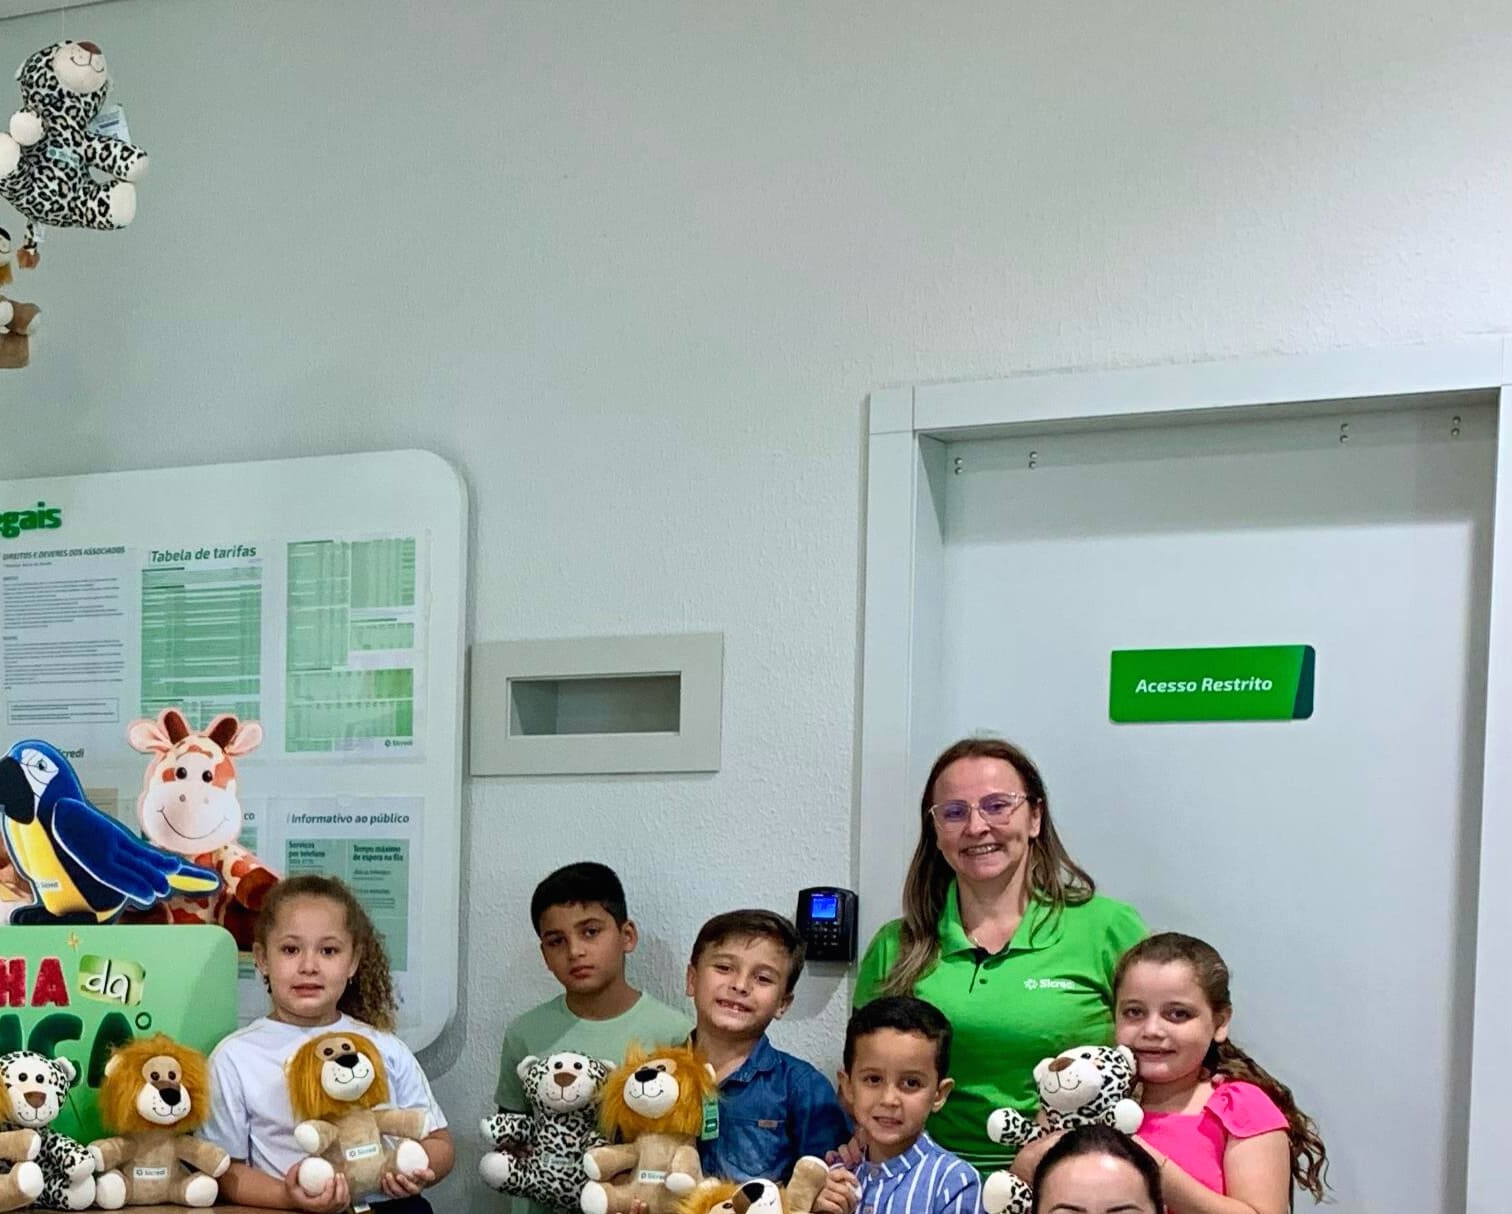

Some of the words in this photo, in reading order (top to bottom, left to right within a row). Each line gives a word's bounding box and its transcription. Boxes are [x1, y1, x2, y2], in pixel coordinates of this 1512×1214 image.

[151, 550, 192, 563] Tabela
[195, 549, 210, 561] de
[213, 545, 257, 559] tarifas
[1136, 679, 1197, 693] Acesso
[1201, 677, 1273, 692] Restrito
[291, 813, 353, 825] Informativo
[355, 815, 368, 824] ao
[370, 812, 410, 826] público
[86, 959, 131, 1004] da
